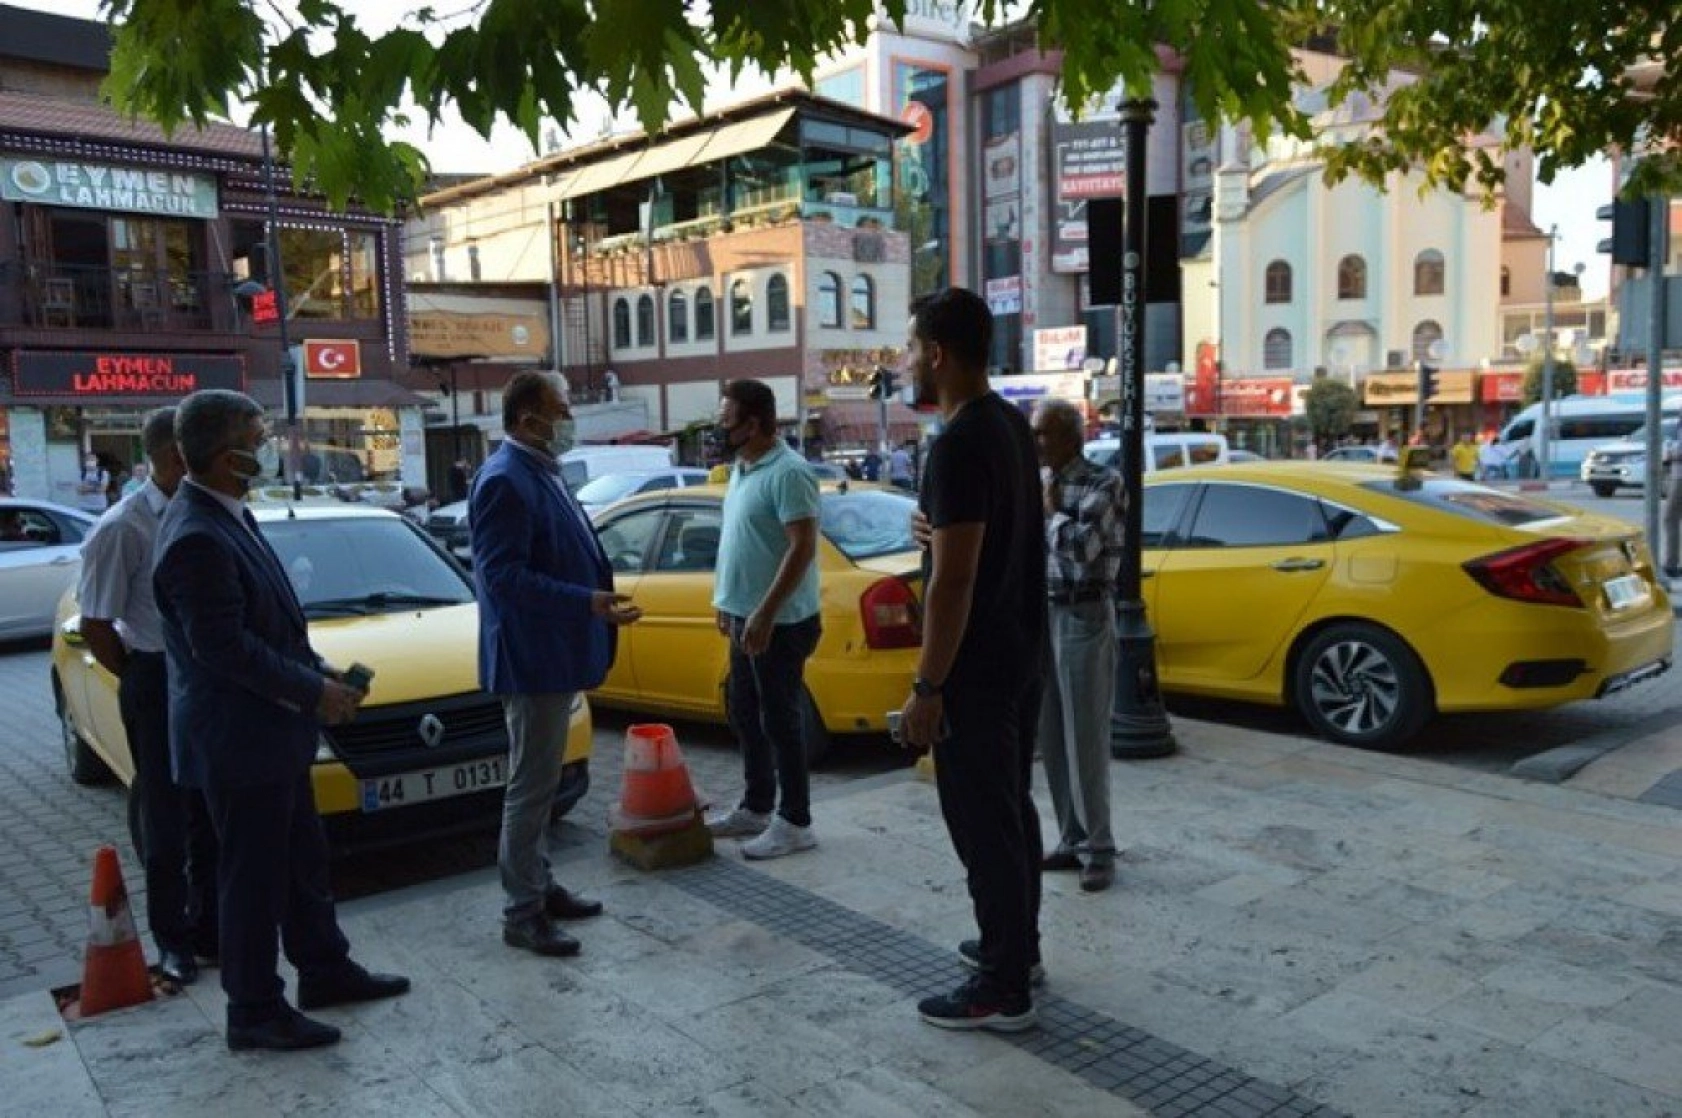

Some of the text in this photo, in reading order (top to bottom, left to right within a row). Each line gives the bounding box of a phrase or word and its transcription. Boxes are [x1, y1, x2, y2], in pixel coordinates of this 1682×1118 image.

[55, 162, 195, 194] EYMEN
[60, 186, 195, 213] LAHMACUN
[96, 356, 172, 375] EYMEN
[74, 373, 196, 391] LAHMACUN
[380, 760, 501, 802] 44 T 0131
